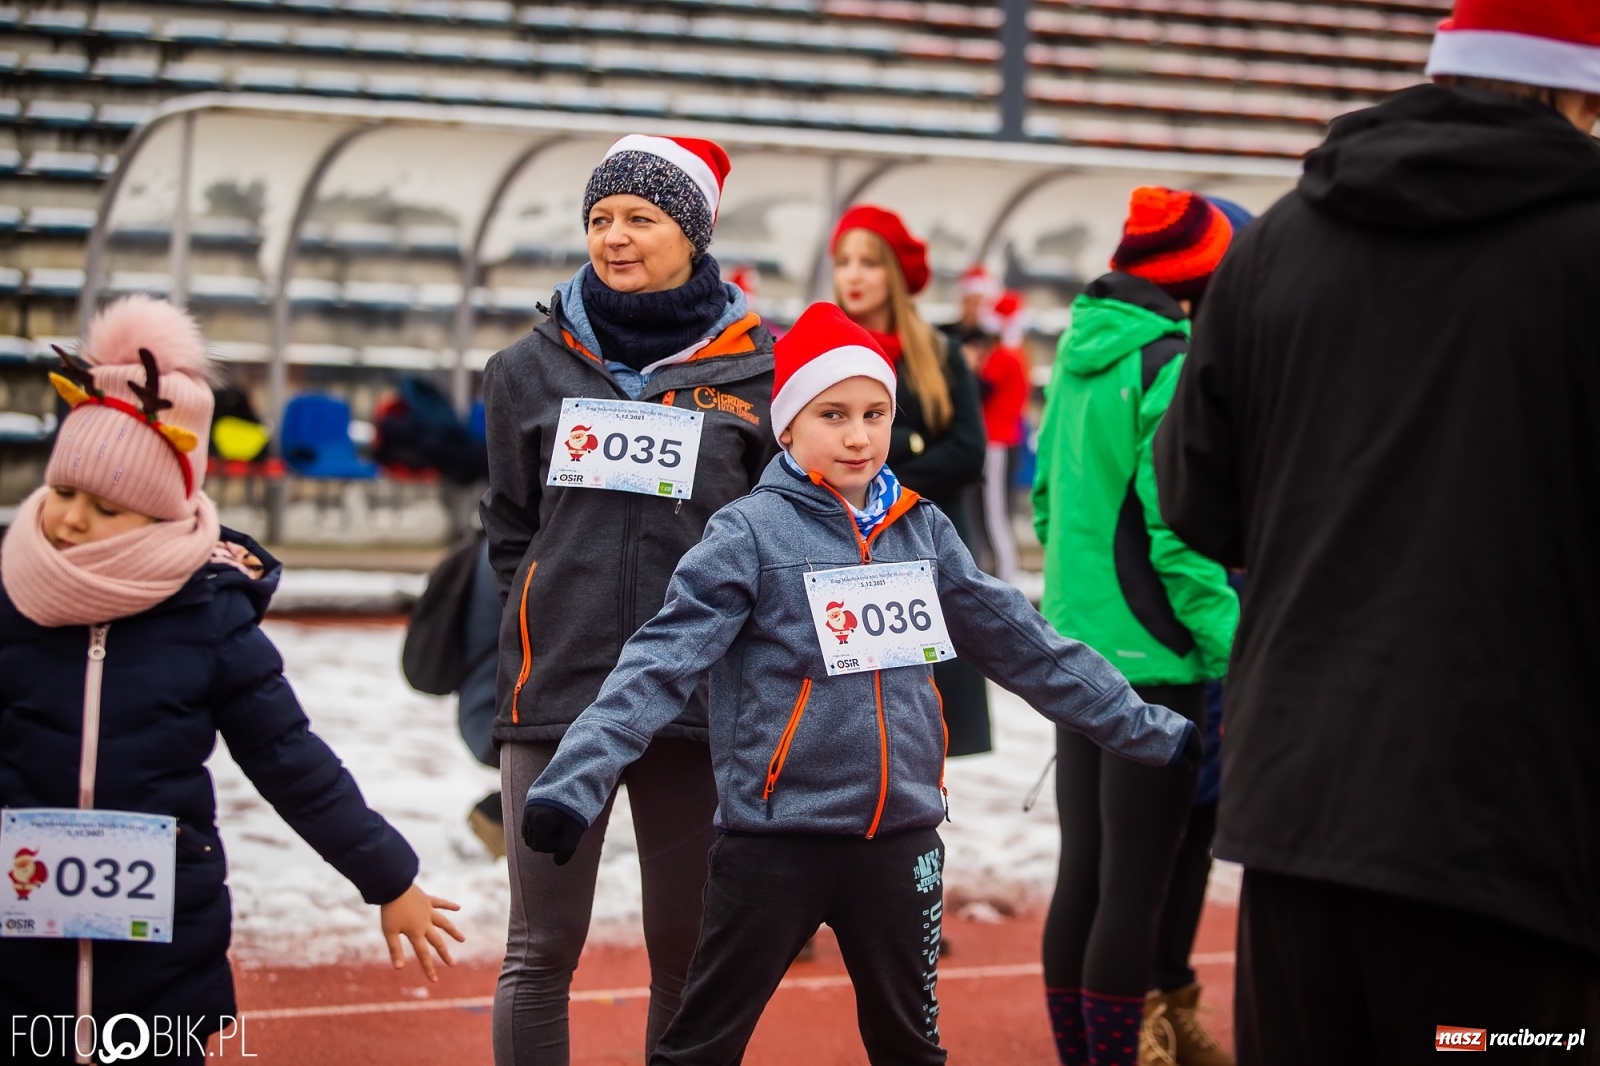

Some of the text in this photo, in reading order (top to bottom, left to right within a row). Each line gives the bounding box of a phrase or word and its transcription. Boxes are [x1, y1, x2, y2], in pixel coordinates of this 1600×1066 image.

[720, 393, 751, 411] CROPP
[603, 432, 682, 468] 035
[861, 598, 932, 637] 036
[56, 856, 156, 900] 032
